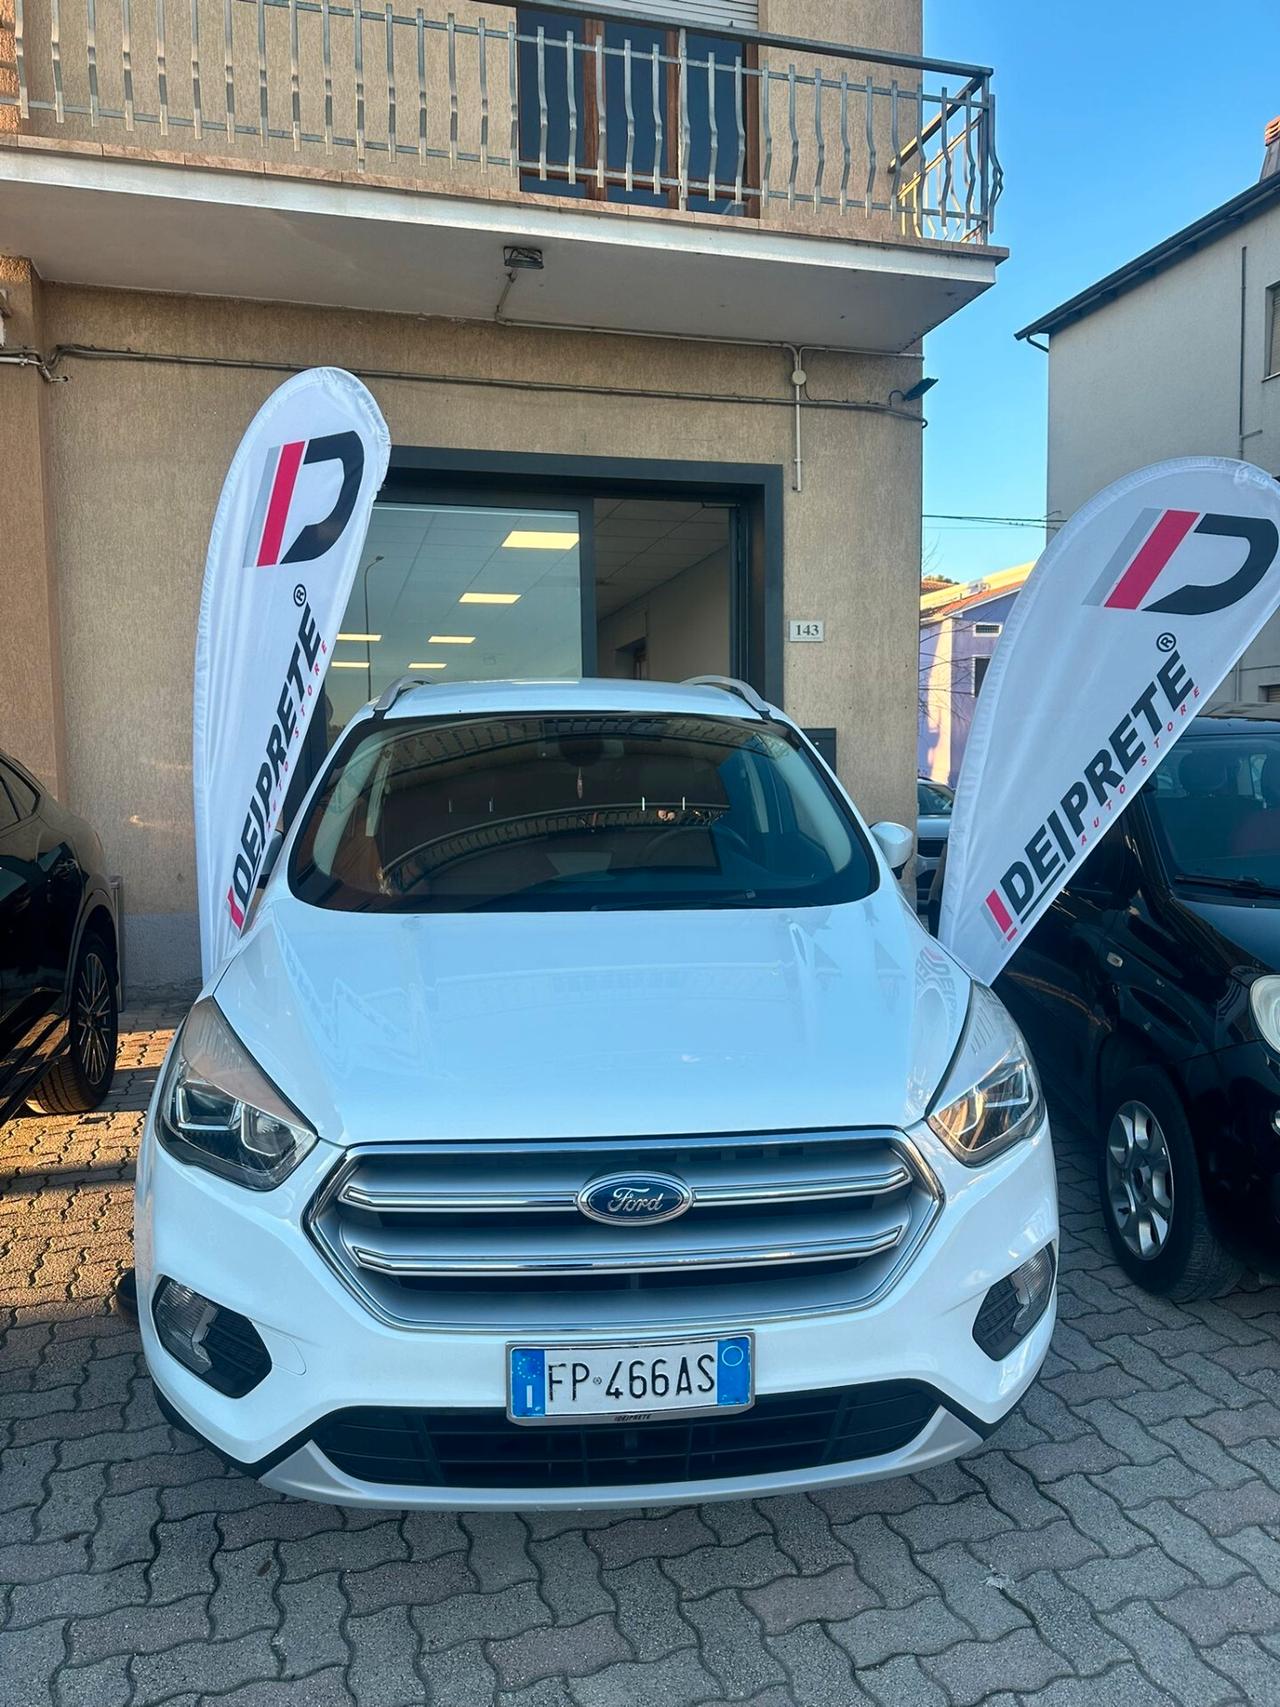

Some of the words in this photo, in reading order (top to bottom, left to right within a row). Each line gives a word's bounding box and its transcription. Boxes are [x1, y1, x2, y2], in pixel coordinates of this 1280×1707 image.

[797, 624, 819, 636] 143
[294, 640, 328, 738] STORE
[1080, 784, 1127, 847] AUTO
[1141, 687, 1200, 767] STORE
[608, 1187, 664, 1212] Ford
[548, 1362, 590, 1401] FP
[605, 1354, 715, 1400] 466AS
